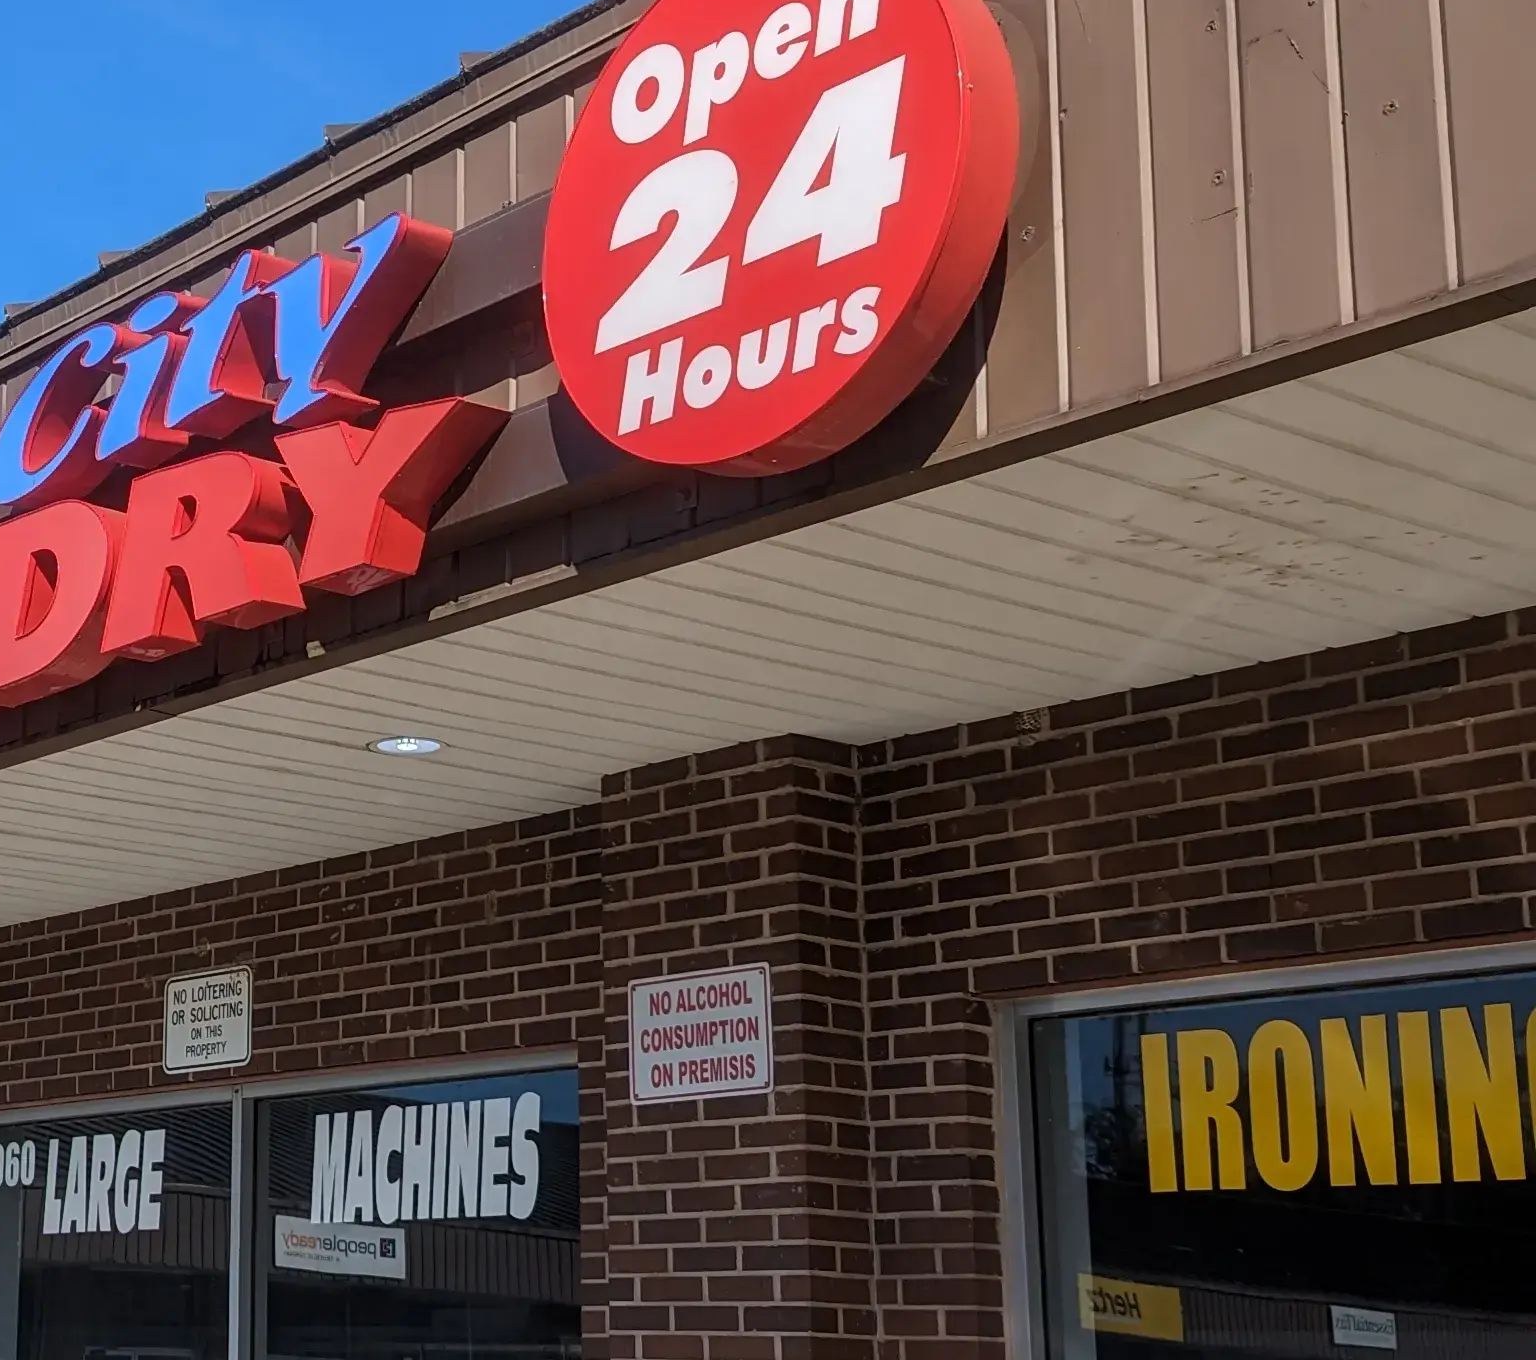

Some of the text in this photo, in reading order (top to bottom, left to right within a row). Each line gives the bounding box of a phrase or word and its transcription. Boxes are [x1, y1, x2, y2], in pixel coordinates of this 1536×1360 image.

[594, 53, 907, 355] 24
[616, 285, 882, 437] Hours
[173, 980, 242, 1006] NO LOITERING
[649, 980, 753, 1017] NO ALCOHOL
[171, 1001, 243, 1026] OR SOLICITING
[185, 1040, 227, 1058] PROPERTY
[190, 1024, 223, 1041] ON THIS
[640, 1016, 760, 1054] CONSUMPTION
[650, 1053, 756, 1089] ON PREMISIS
[1140, 1003, 1536, 1193] IRONIN
[42, 1129, 166, 1235] LARGE
[310, 1092, 541, 1224] MACHINES
